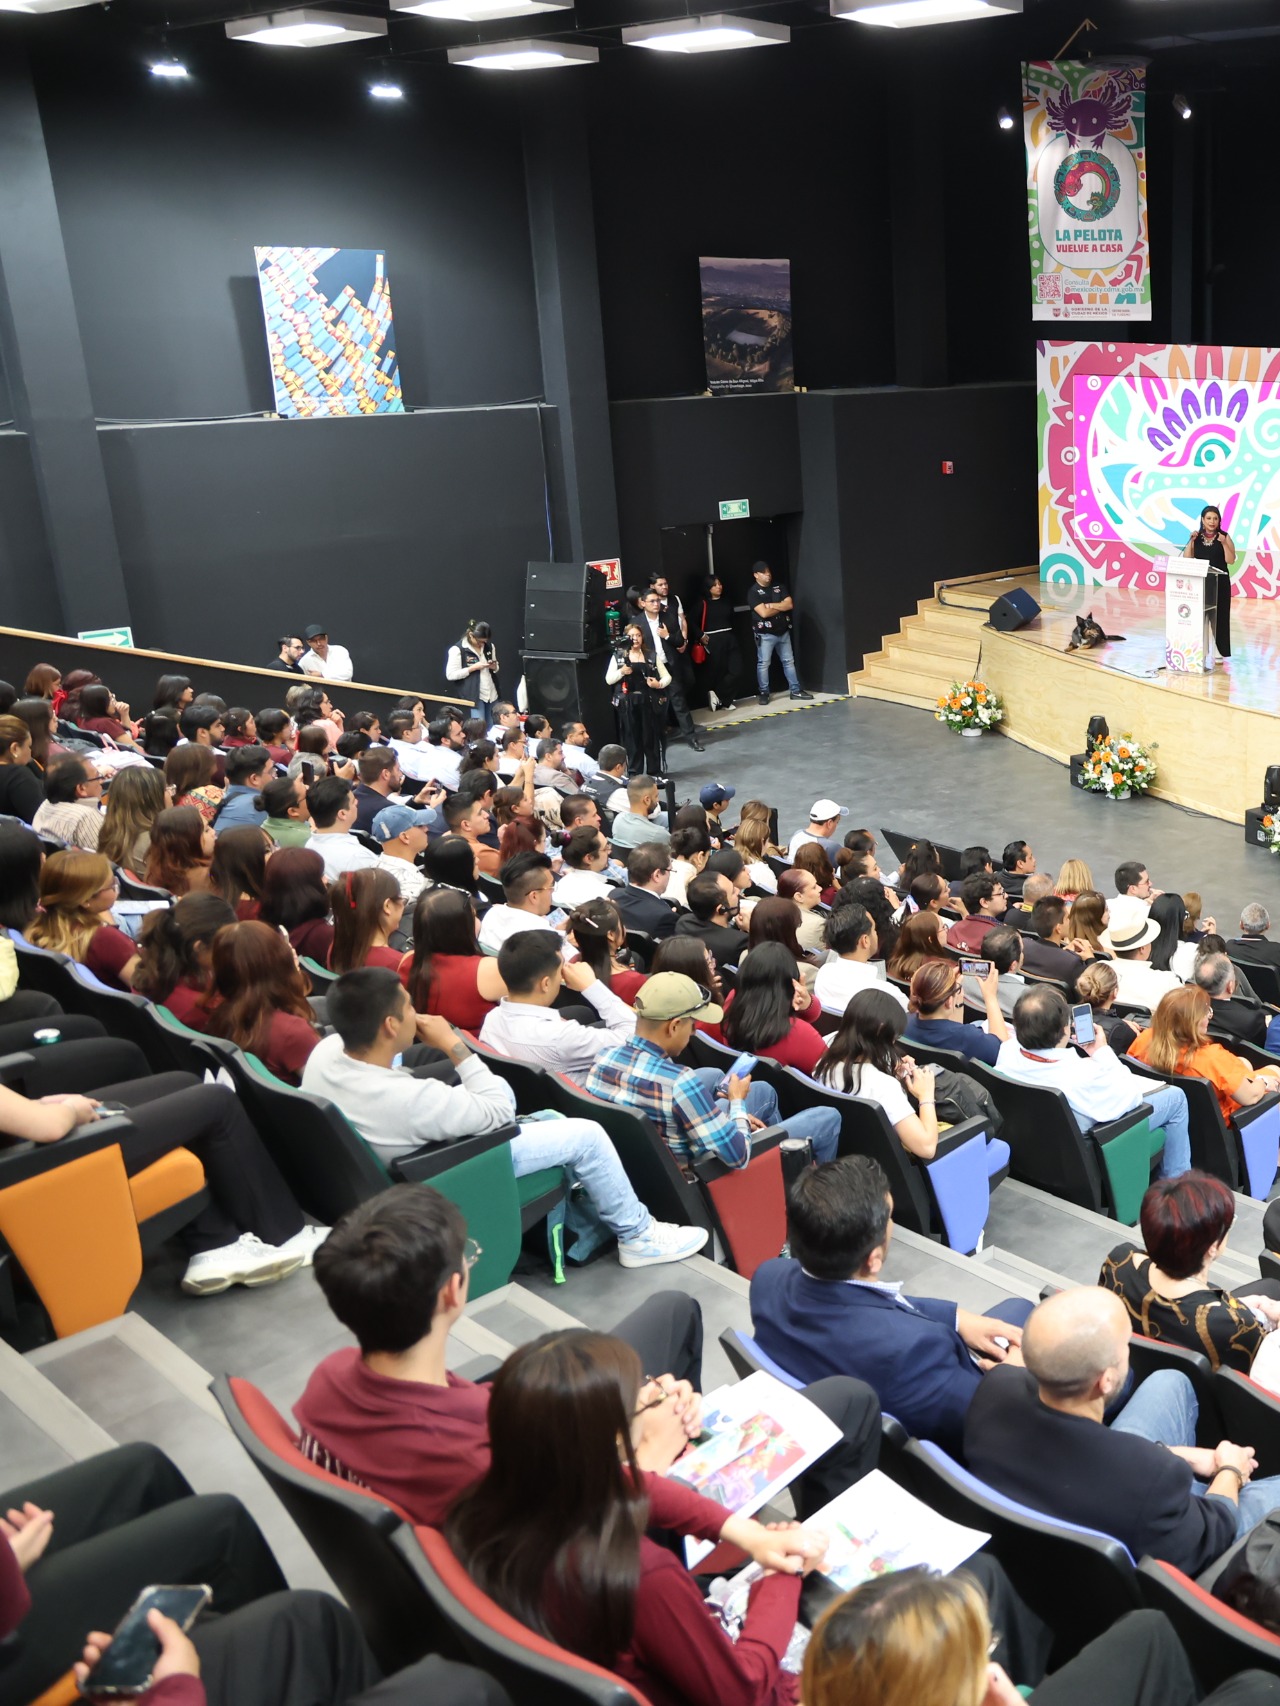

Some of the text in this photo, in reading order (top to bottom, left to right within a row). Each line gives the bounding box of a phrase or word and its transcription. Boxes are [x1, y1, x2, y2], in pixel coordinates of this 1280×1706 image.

[1055, 229, 1122, 241] LA PELOTA
[1056, 244, 1123, 252] VUELVE A CASA
